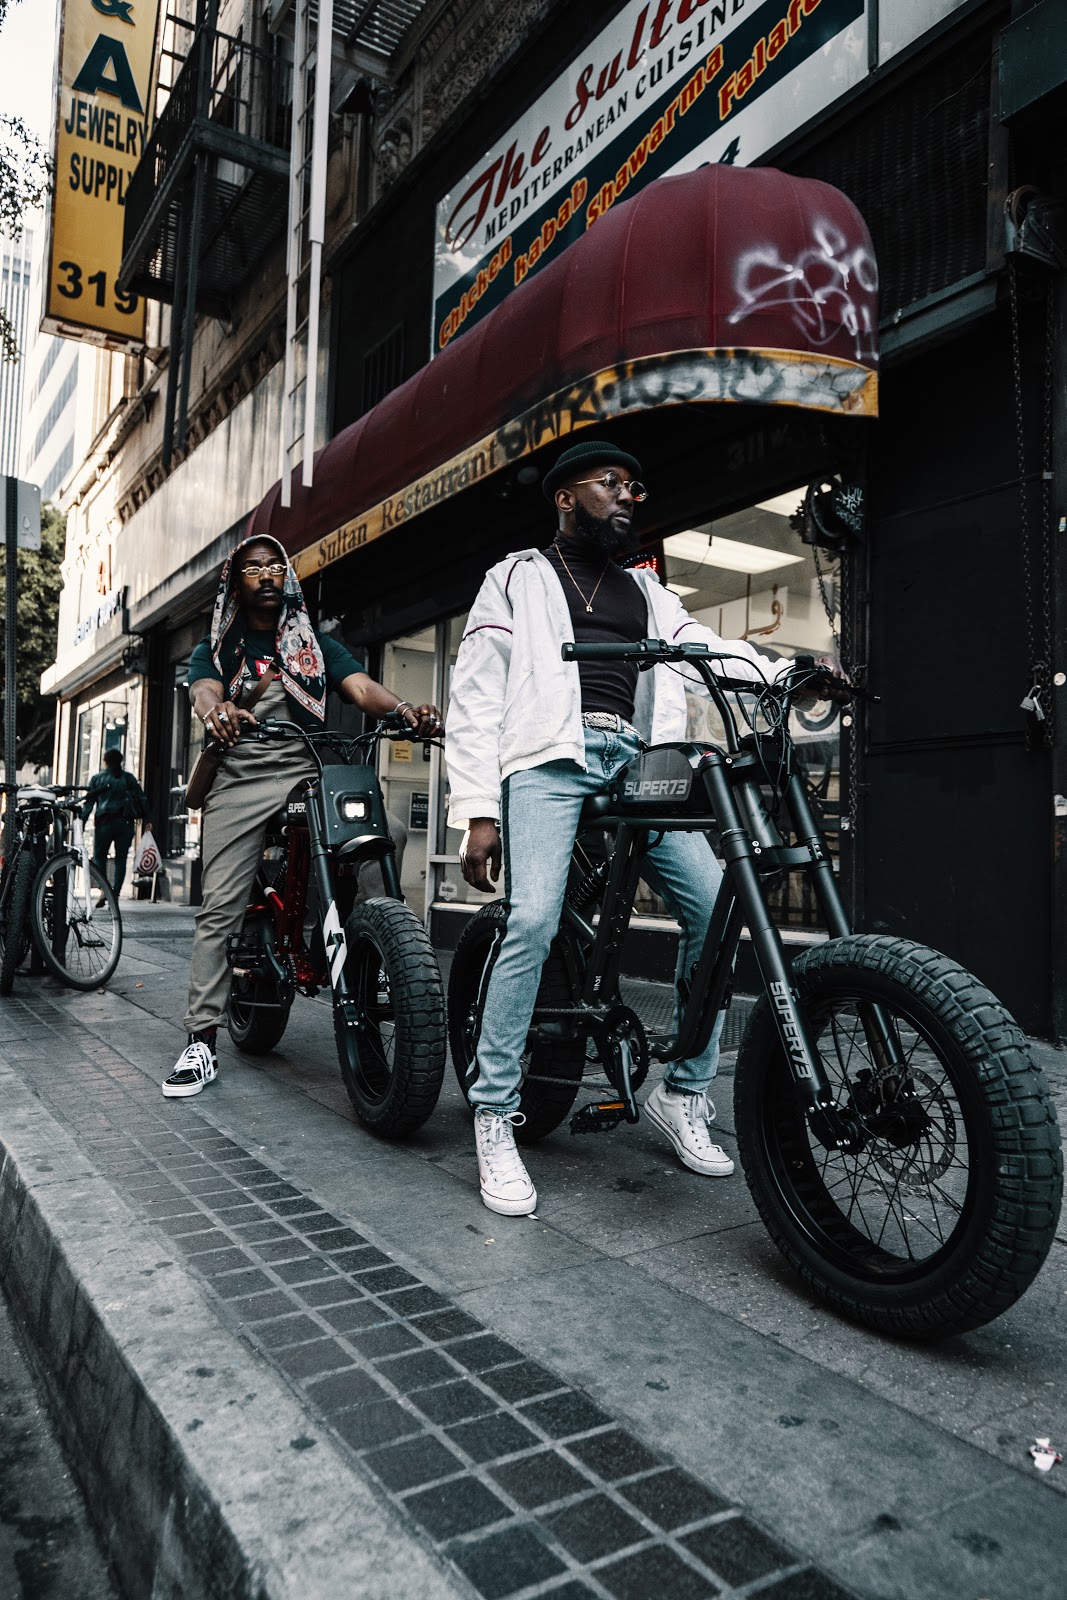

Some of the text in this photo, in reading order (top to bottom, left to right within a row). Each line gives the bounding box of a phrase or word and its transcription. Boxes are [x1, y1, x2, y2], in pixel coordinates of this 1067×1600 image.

[72, 33, 145, 115] A
[69, 152, 132, 206] SUPPL
[445, 126, 552, 254] The
[485, 92, 628, 246] MEDITERRANEAN
[57, 261, 139, 315] 319
[317, 438, 498, 568] Sultan Restaurant
[288, 802, 307, 814] SUPER
[623, 778, 688, 798] SUPER73
[769, 979, 813, 1080] SUPER73
